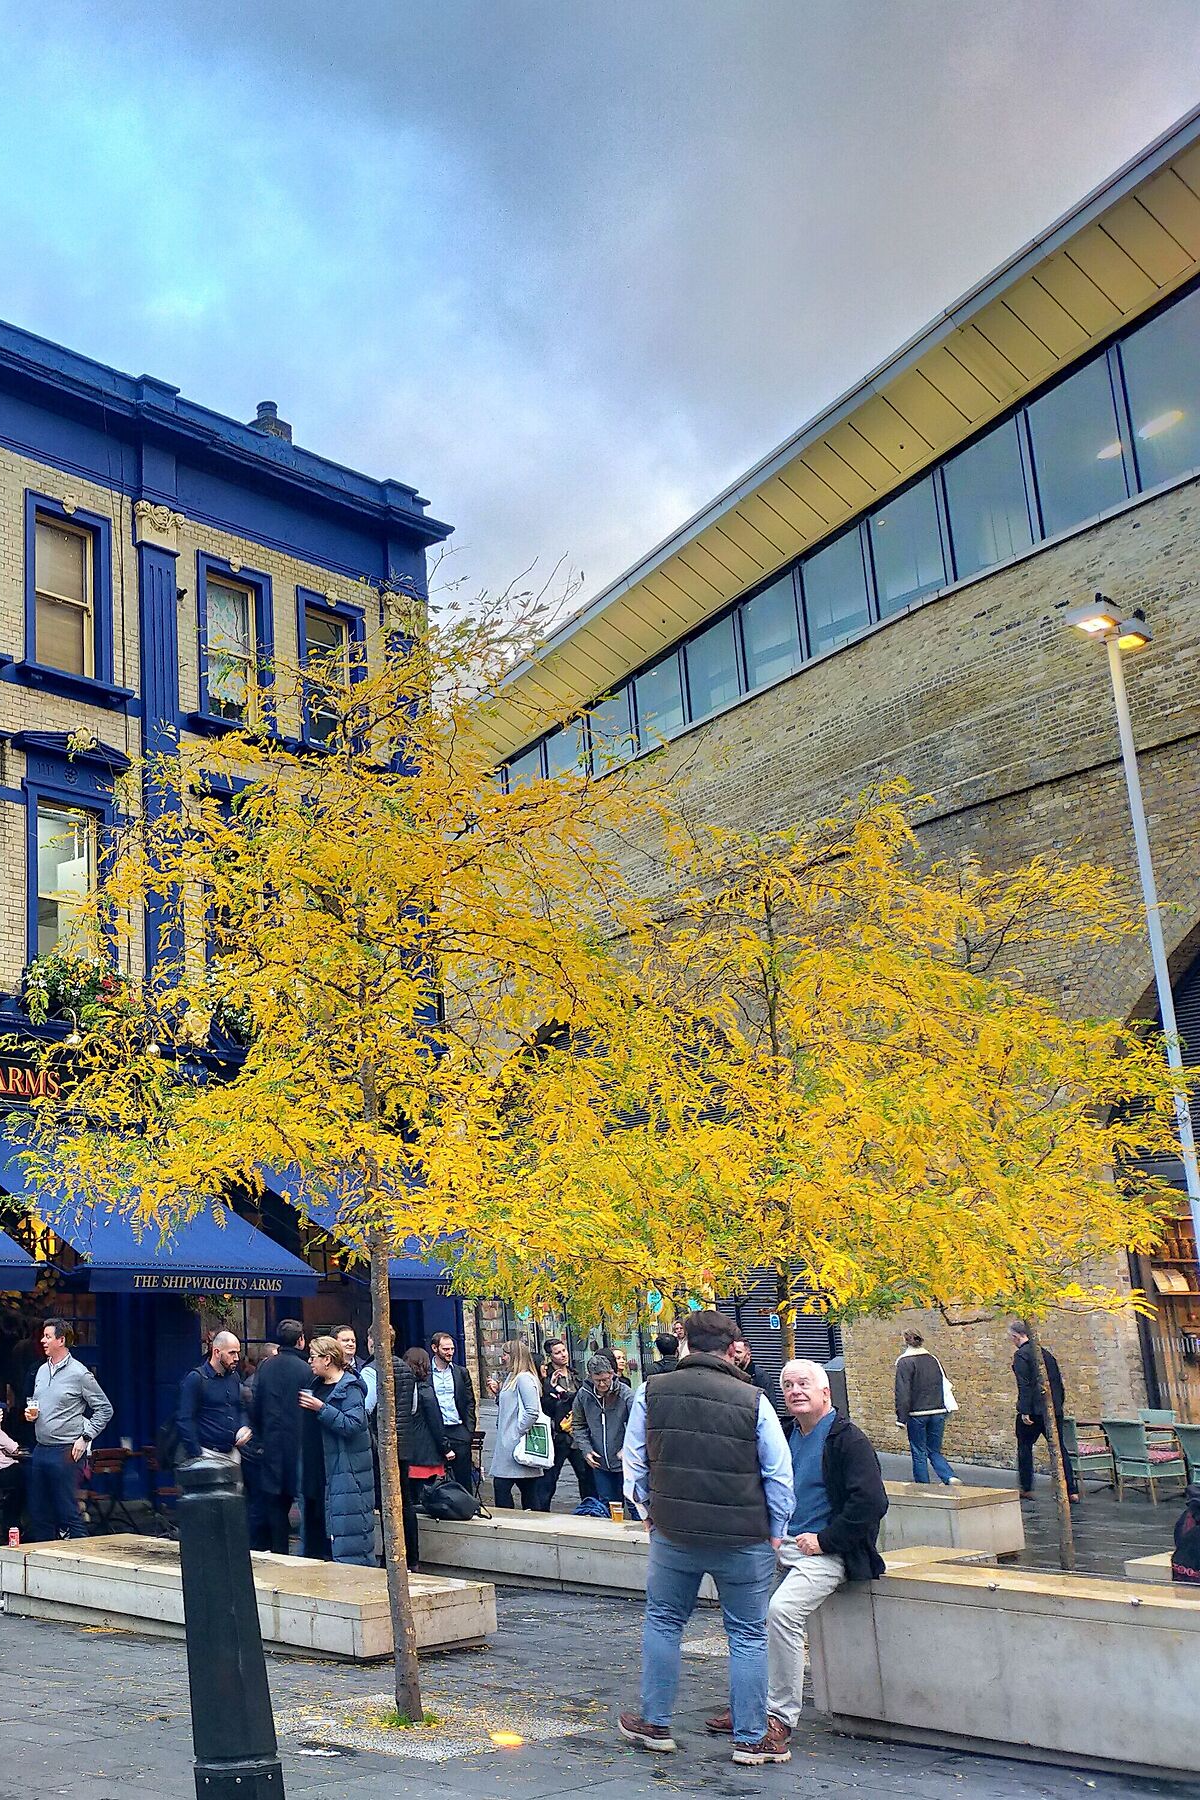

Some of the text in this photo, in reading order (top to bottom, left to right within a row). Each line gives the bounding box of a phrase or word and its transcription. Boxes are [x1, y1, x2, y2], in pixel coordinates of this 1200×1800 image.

[133, 1275, 283, 1292] THE SHIPWRIGHTS ARMS
